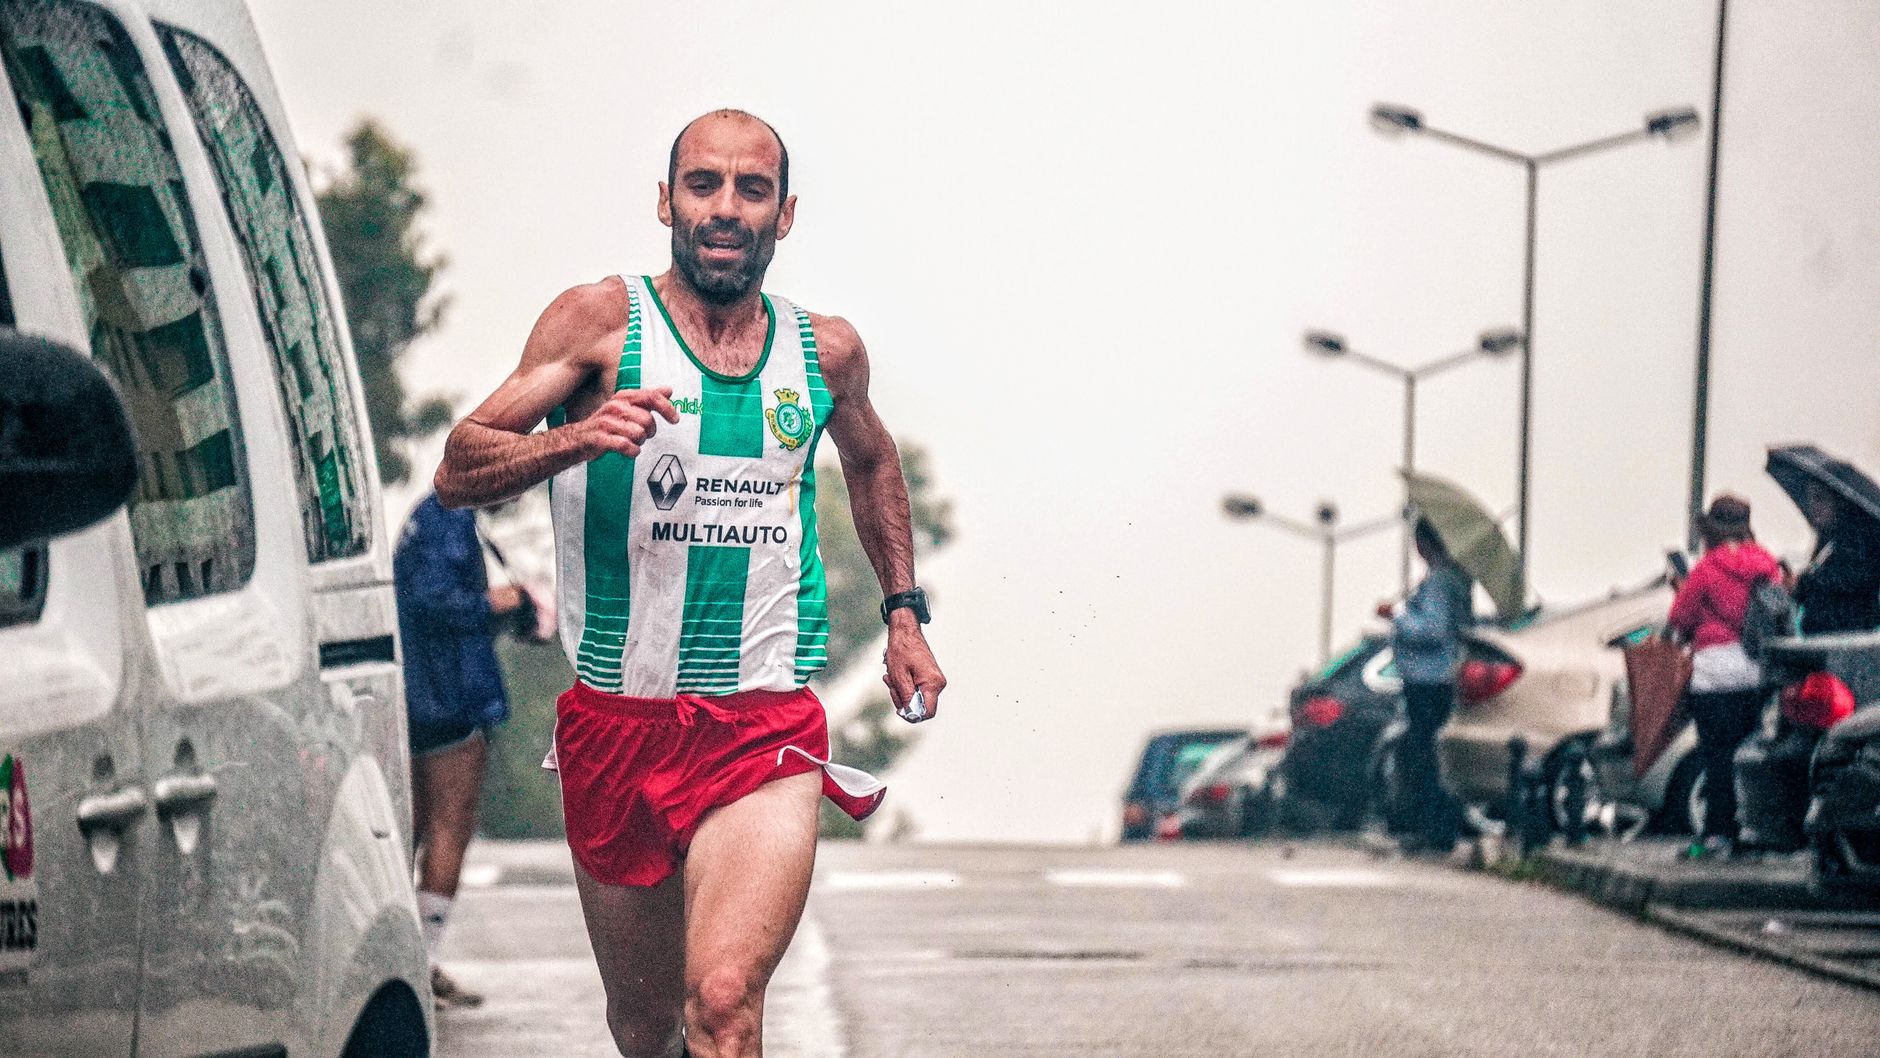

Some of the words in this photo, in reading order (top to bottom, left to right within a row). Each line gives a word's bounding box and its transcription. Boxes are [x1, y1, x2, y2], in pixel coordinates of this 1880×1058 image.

[695, 477, 785, 496] RENAULT
[695, 495, 732, 508] Passion
[734, 497, 748, 508] for
[749, 498, 763, 508] life
[652, 521, 788, 545] MULTIAUTO
